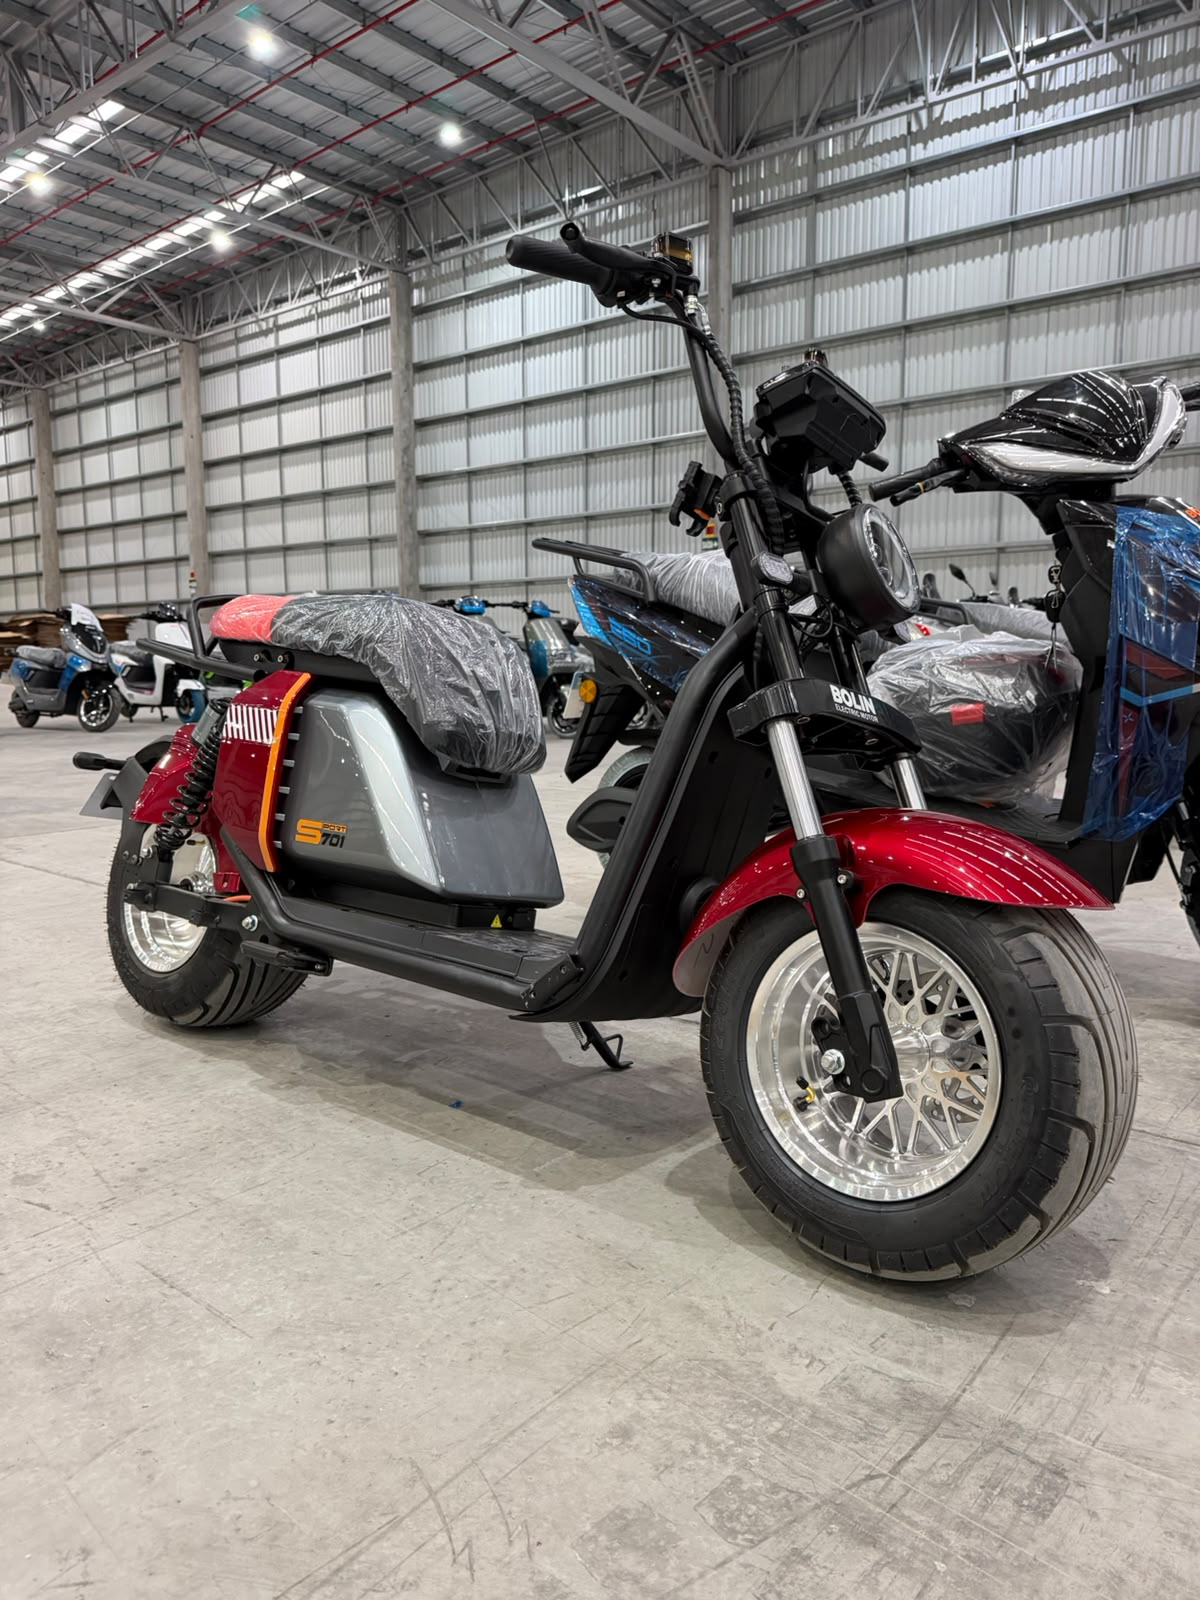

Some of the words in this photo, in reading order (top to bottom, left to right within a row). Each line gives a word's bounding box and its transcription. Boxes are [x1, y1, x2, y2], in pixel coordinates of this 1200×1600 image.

[829, 684, 876, 715] BOLIN
[835, 703, 861, 718] ELECTRIC
[860, 711, 879, 724] MOTOR
[295, 818, 347, 845] SPORT
[321, 832, 346, 849] 701
